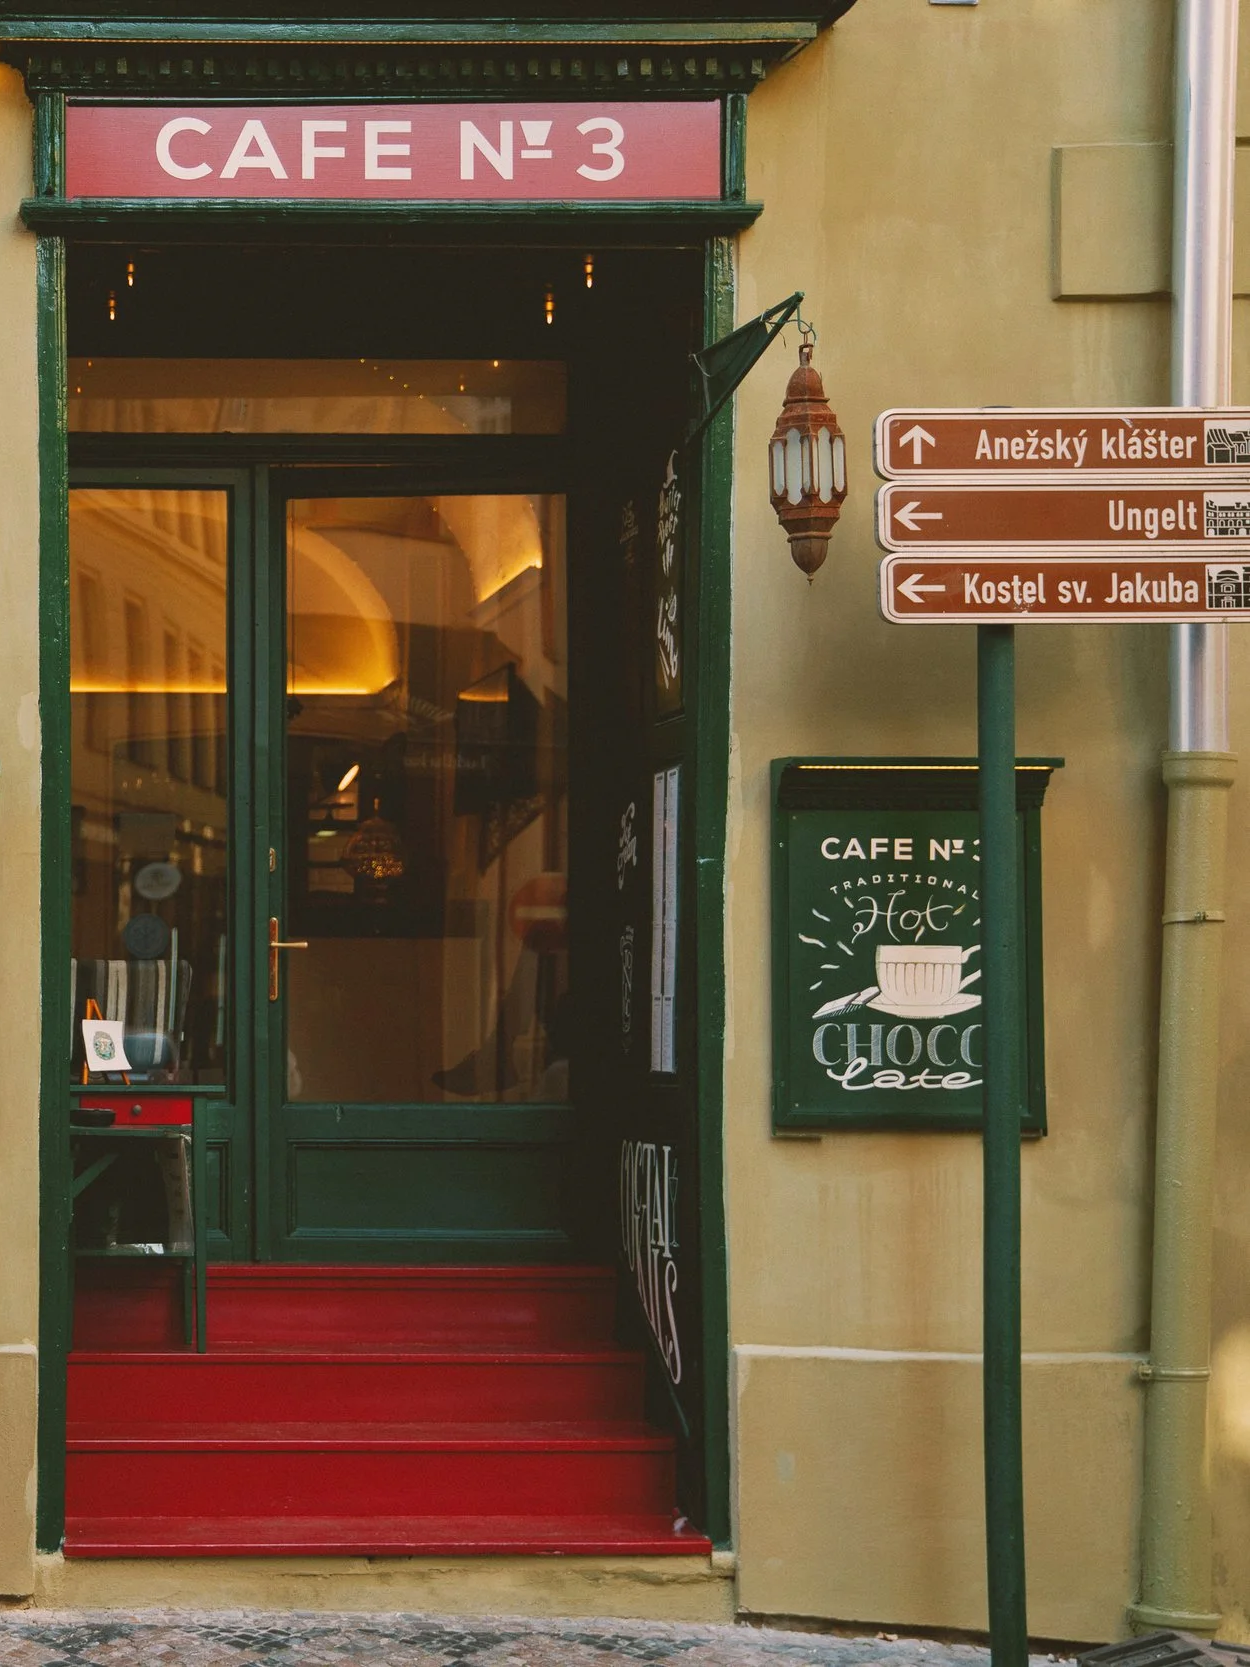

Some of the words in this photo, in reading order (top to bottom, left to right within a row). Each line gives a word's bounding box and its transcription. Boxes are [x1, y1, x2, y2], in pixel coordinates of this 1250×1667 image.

[155, 117, 412, 181] CAFE
[576, 117, 625, 182] 3
[975, 428, 1088, 468] Anežský
[1102, 427, 1197, 460] klášter
[1108, 499, 1198, 539] Ungelt
[963, 573, 1046, 604] Kostel
[1058, 580, 1092, 604] sv.
[1104, 572, 1199, 604] Jakuba
[820, 837, 913, 861] CAFE
[829, 873, 980, 901] TRADITIONAL
[851, 889, 955, 944] Hot
